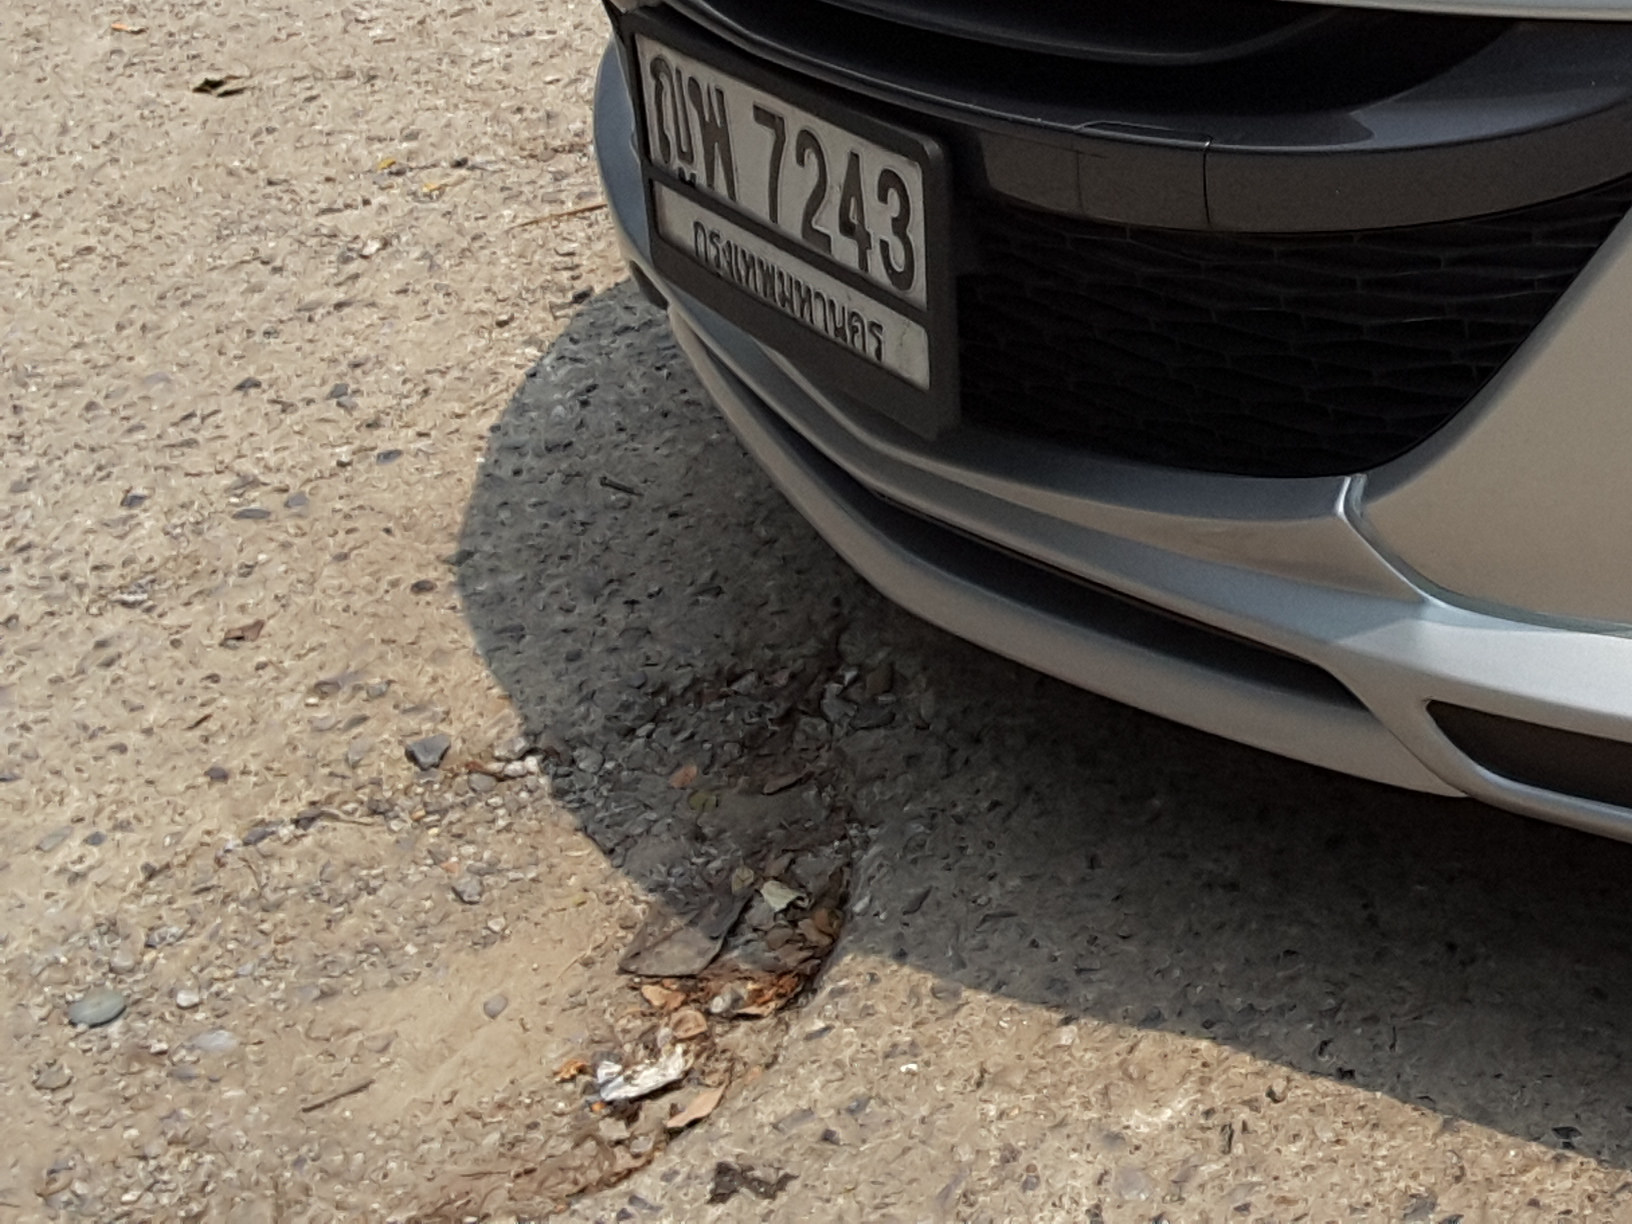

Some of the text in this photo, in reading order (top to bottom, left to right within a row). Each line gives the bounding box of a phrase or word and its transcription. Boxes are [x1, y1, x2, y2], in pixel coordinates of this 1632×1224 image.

[753, 104, 916, 292] 7243
[693, 220, 885, 363] กรงเทพมหานคร
